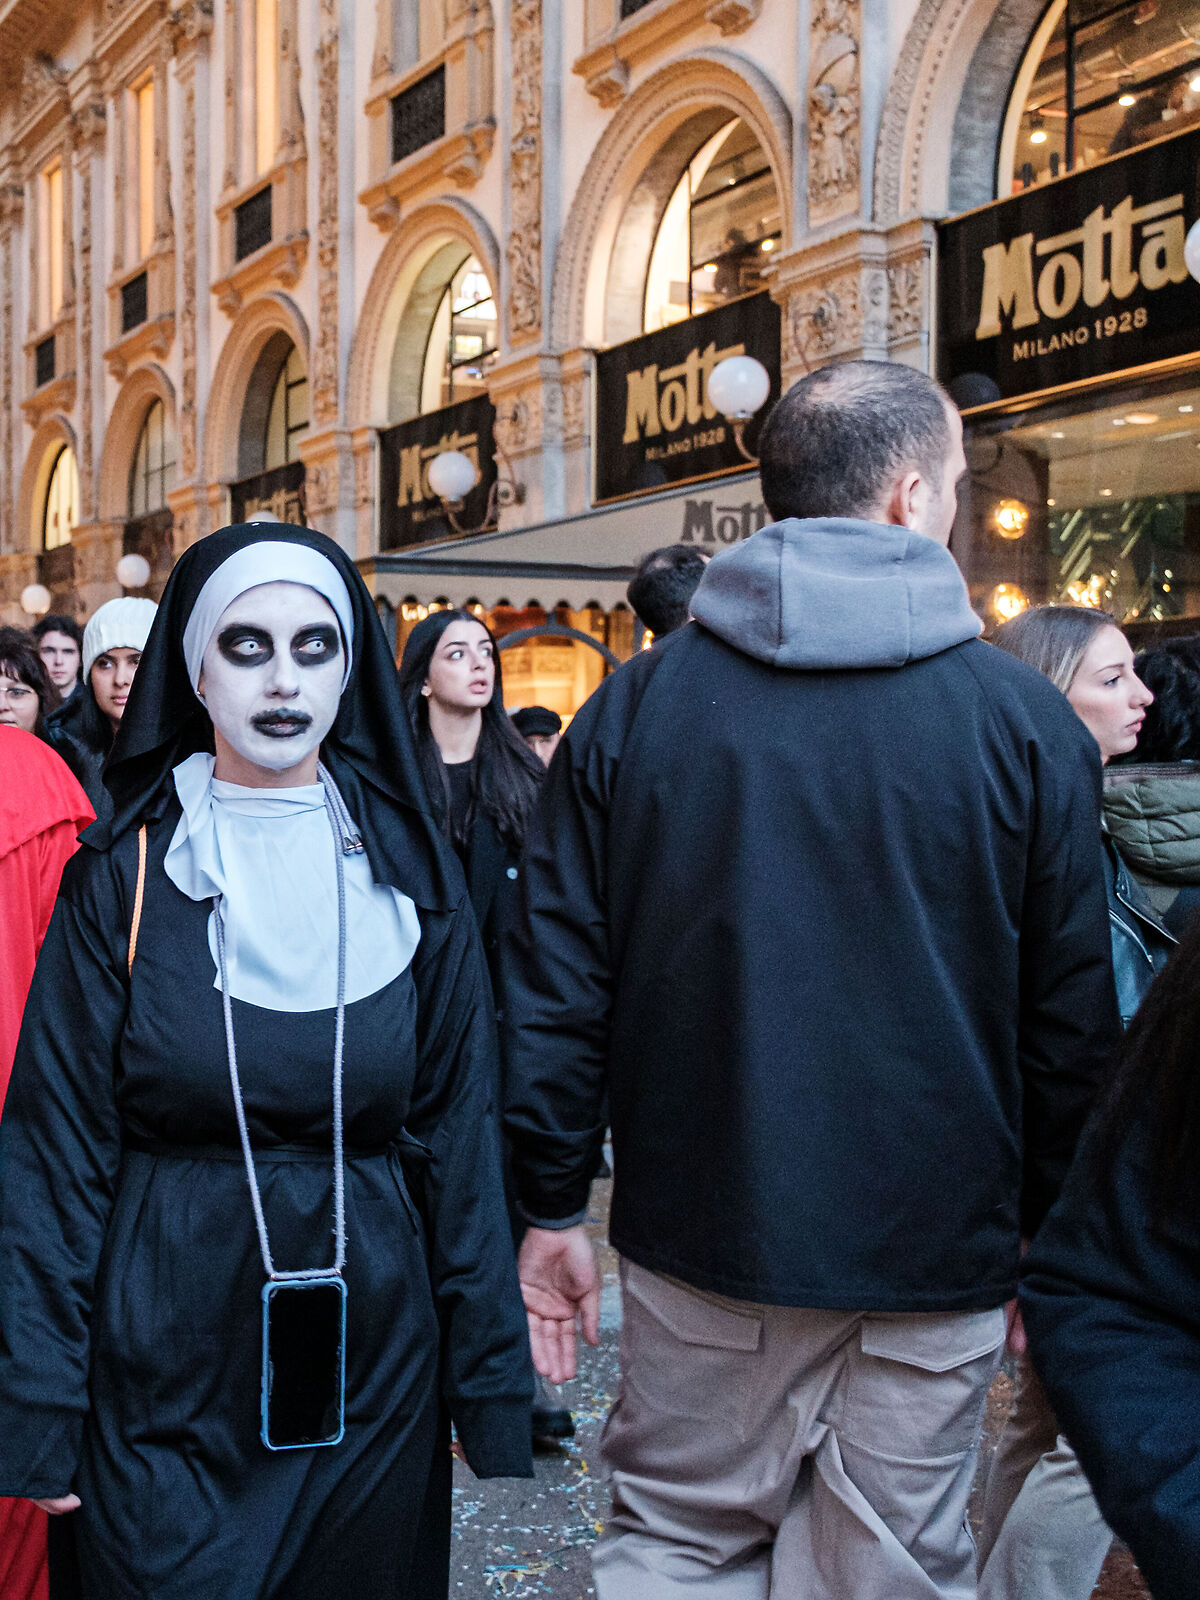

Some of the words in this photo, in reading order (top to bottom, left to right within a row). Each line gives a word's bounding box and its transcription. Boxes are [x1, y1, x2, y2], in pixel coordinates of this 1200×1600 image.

[976, 193, 1189, 341] Motta
[1012, 326, 1089, 362] MILANO
[1095, 307, 1149, 340] 1928
[623, 341, 746, 444] Mott
[680, 499, 767, 544] Mott
